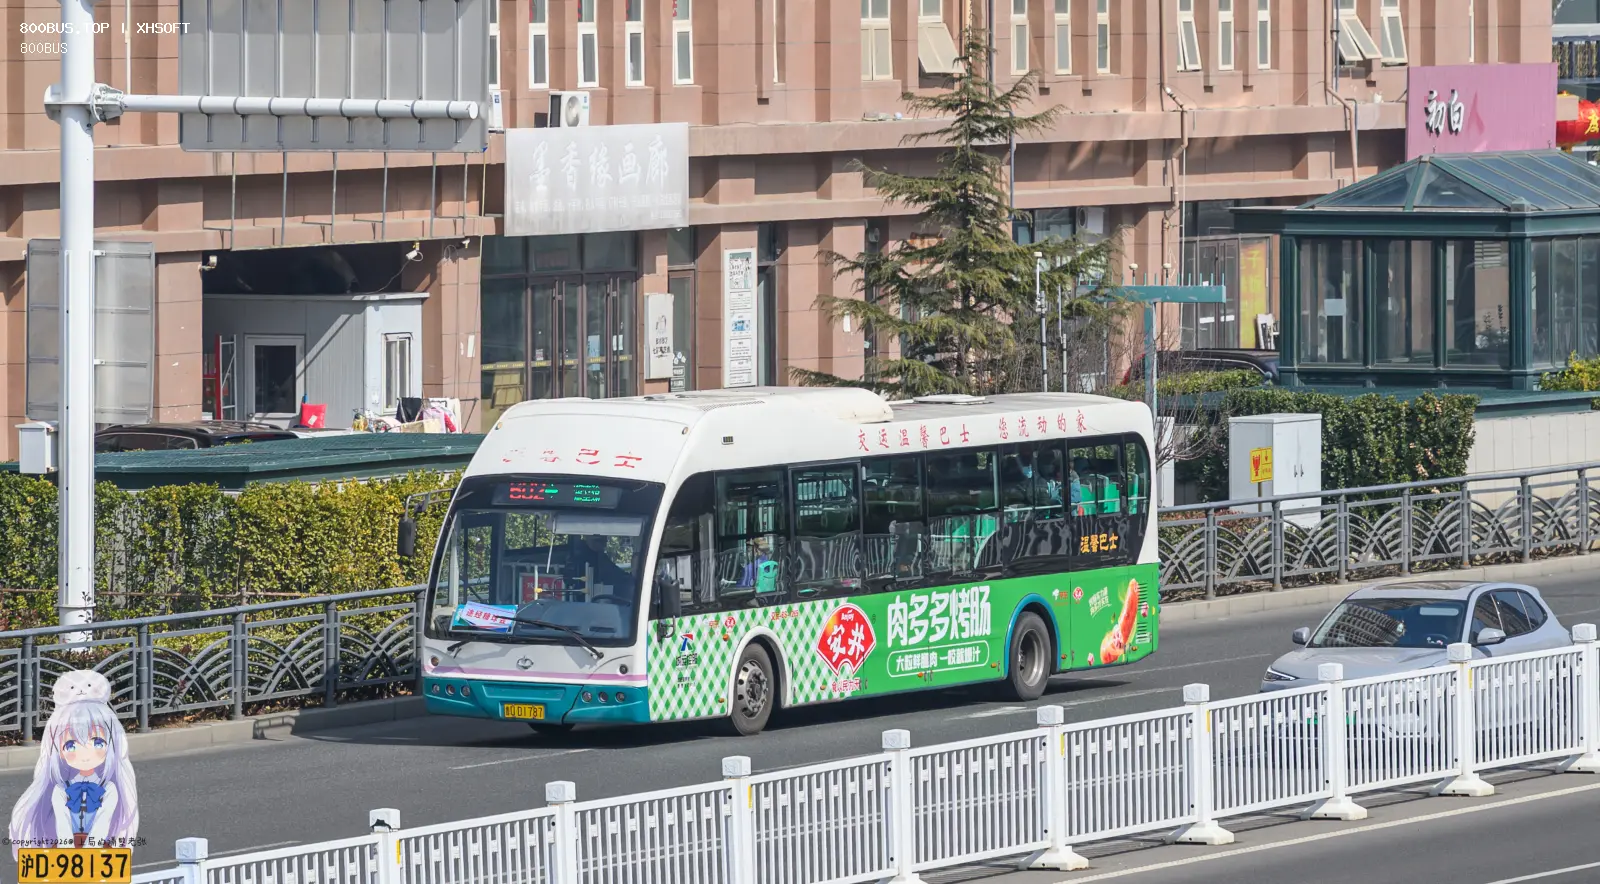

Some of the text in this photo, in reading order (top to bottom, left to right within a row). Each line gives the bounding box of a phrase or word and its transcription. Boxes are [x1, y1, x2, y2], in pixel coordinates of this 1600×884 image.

[529, 133, 670, 192] 墨香缘画廊
[858, 409, 1088, 452] 交运温馨巴士 您流动的家
[1080, 532, 1119, 553] 温馨巴士
[887, 585, 992, 648] 肉多多烤肠
[827, 622, 865, 662] 安井
